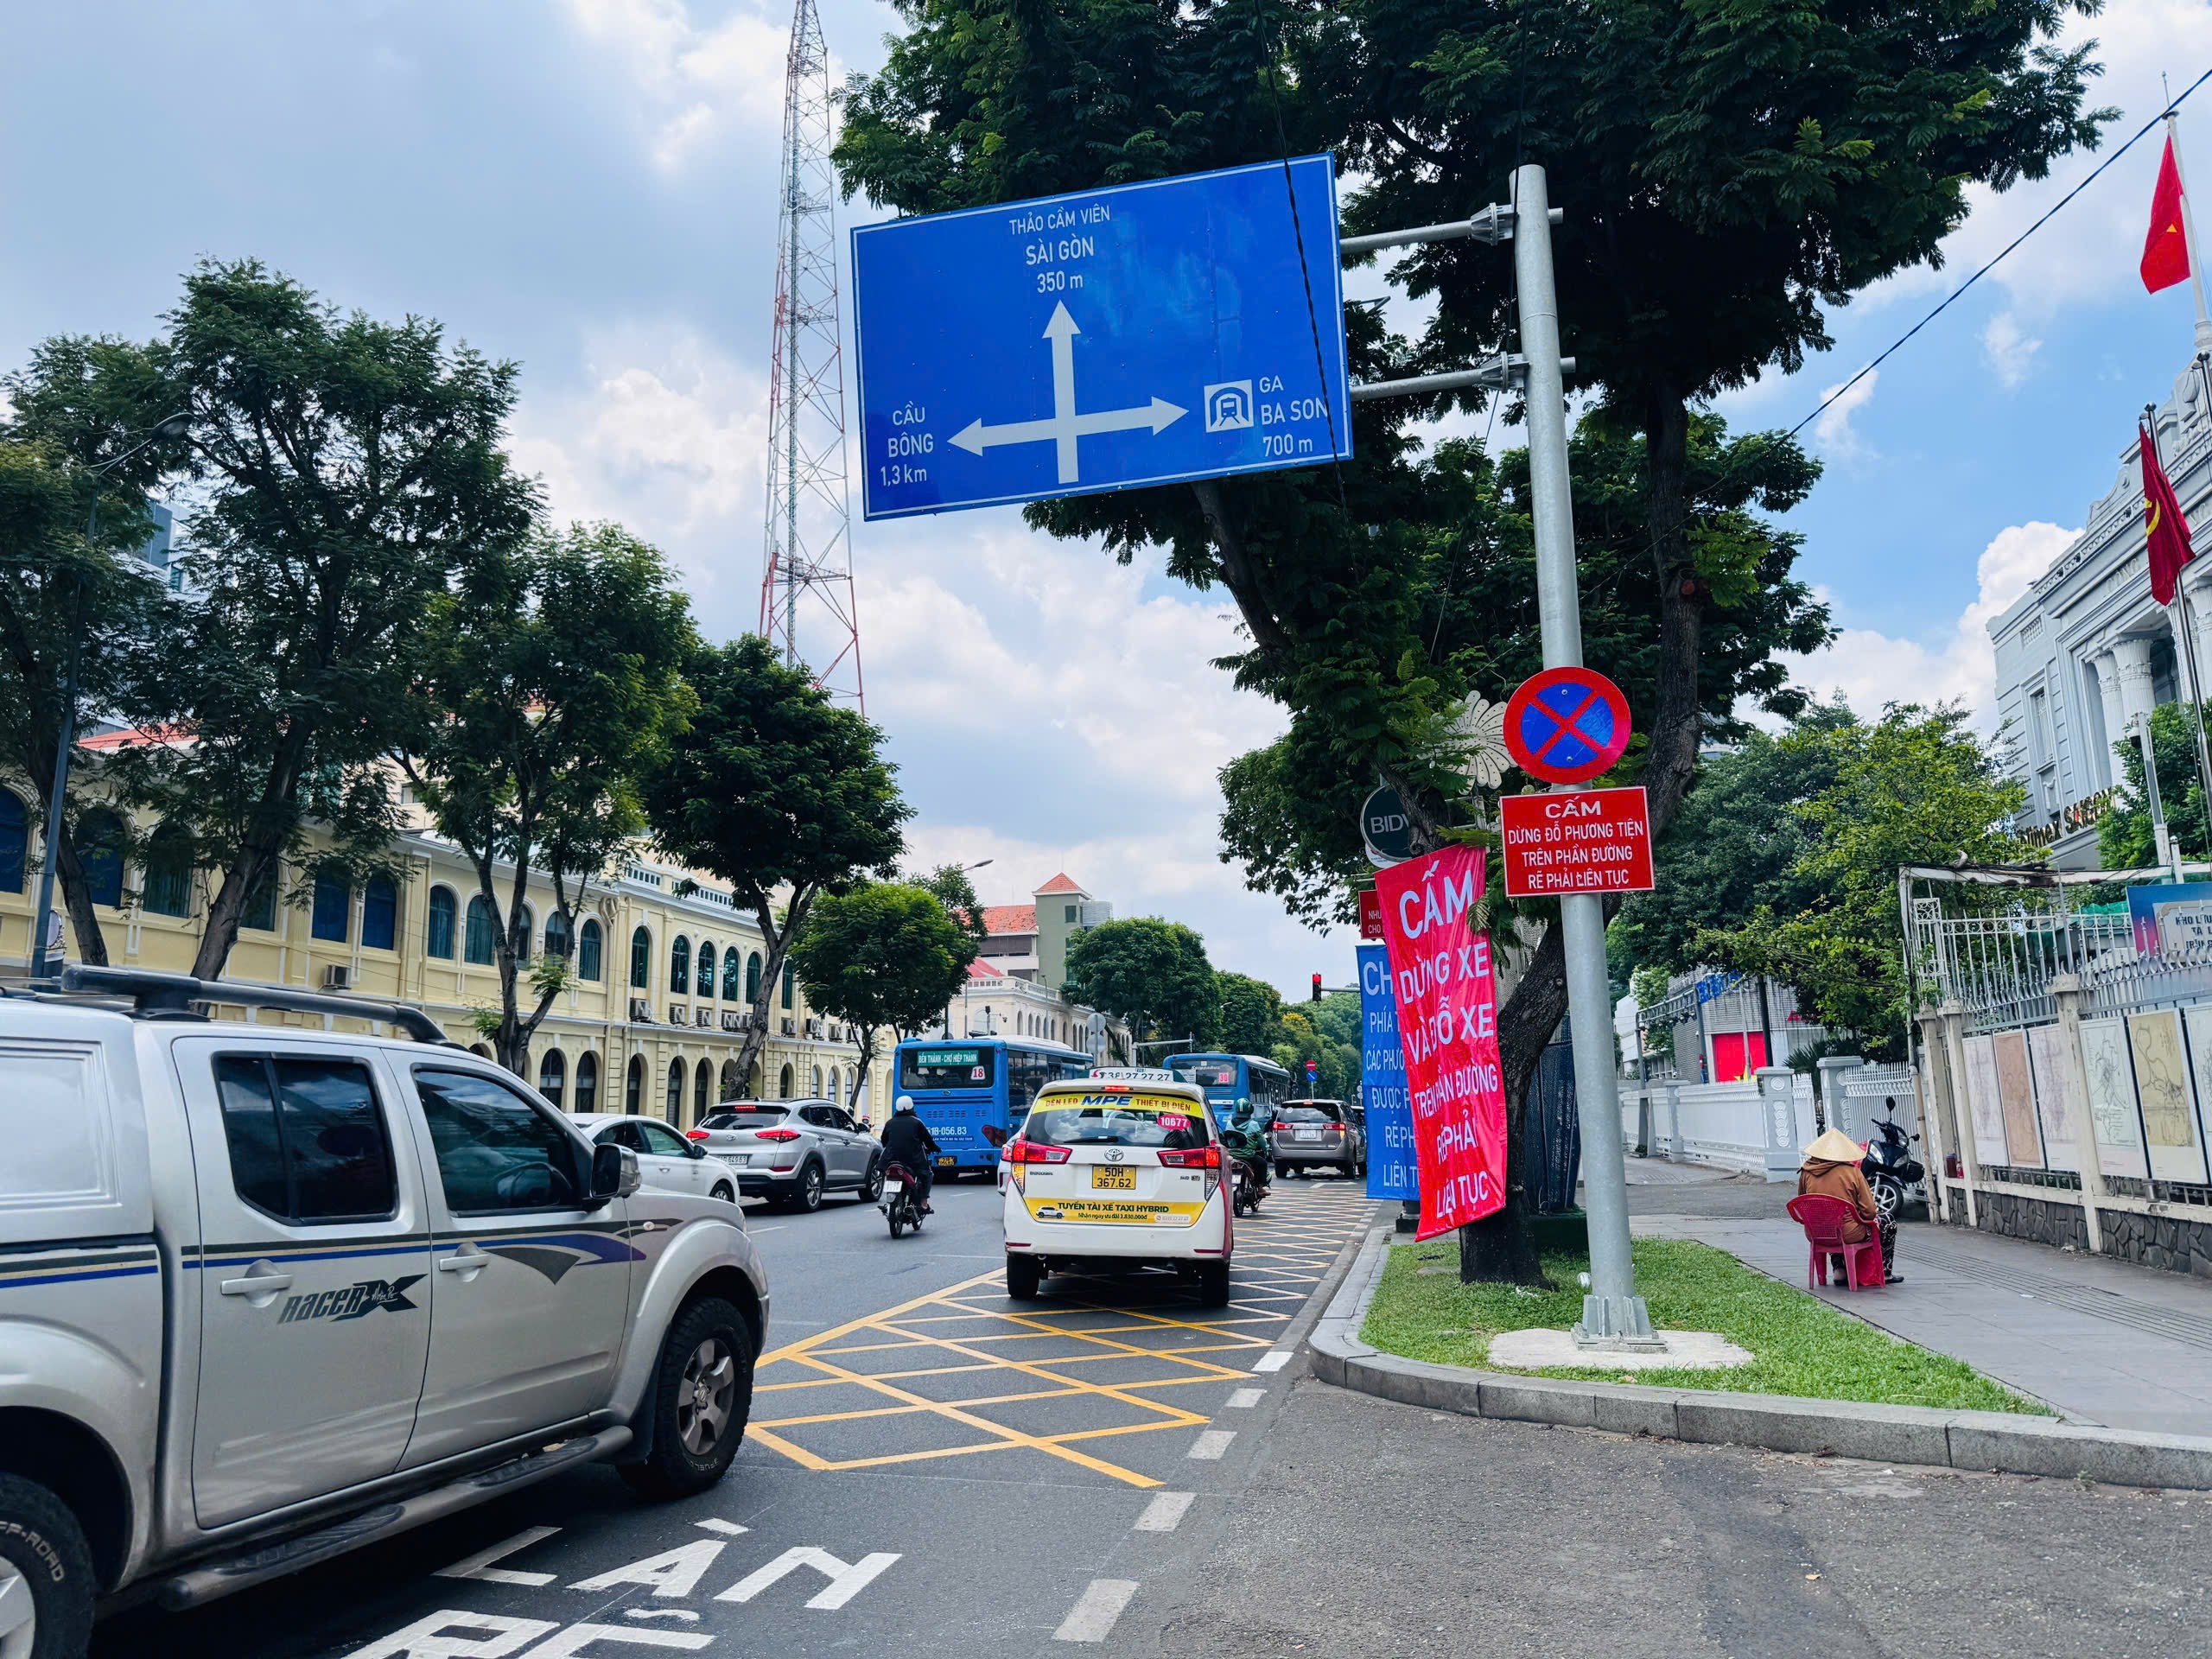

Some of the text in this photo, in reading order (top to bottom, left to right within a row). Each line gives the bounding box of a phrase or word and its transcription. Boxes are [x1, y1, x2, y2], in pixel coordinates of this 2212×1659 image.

[1009, 203, 1110, 235] THẢO CẦM VIÊN
[1026, 233, 1094, 265] SÀI GÒN
[1037, 270, 1084, 293] 350 m
[1259, 375, 1284, 393] GA
[893, 400, 925, 426] CẦU
[1261, 397, 1329, 425] BA SON
[888, 432, 934, 458] BÔNG
[1262, 433, 1313, 457] 700 m
[880, 464, 927, 486] 1,3 km
[1545, 796, 1602, 818] CẤM
[1508, 818, 1644, 845] DỪNG ĐỖ PHƯƠNG TIỆN
[1522, 842, 1633, 868] TRÊN PHẦN ĐƯỜNG
[1528, 868, 1630, 889] RẼ PHẢI LIÊN TỤC
[1399, 860, 1473, 939] CẤM
[1368, 924, 1382, 934] CHO
[1363, 961, 1394, 996] CH
[1399, 941, 1490, 1004] DỪNG XE
[1370, 1004, 1393, 1033] PHÍA
[1406, 1016, 1432, 1065] VÀ
[1428, 995, 1453, 1052] ĐỖ
[1459, 1002, 1493, 1041] XE
[918, 1052, 927, 1064] BẾN
[927, 1052, 942, 1064] THÀNH
[944, 1052, 953, 1065] CHỢ
[963, 1052, 977, 1063] THÀNH
[1366, 1046, 1405, 1071] CÁC PHƯƠ
[973, 1068, 983, 1078] 18
[1372, 1085, 1402, 1115] ĐƯỢC
[1414, 1083, 1437, 1120] TRÊN
[1436, 1065, 1454, 1107] PẦN
[1455, 1057, 1497, 1098] ĐƯỜNG
[1081, 1095, 1133, 1106] MPE
[1135, 1097, 1159, 1107] THIẾT
[1161, 1100, 1170, 1109] BỊ
[1172, 1101, 1191, 1111] ĐIỆN
[1160, 1117, 1187, 1128] 10677
[1385, 1121, 1399, 1148] RẼ
[1444, 1109, 1479, 1157] PHẢI
[1096, 1178, 1131, 1188] 367.62
[1105, 1167, 1123, 1177] 50H
[1383, 1160, 1408, 1188] LIÊN
[1458, 1171, 1489, 1211] TỤC
[1086, 1202, 1101, 1211] TÀI
[1103, 1202, 1114, 1211] XẾ
[430, 1518, 903, 1611] LÀN
